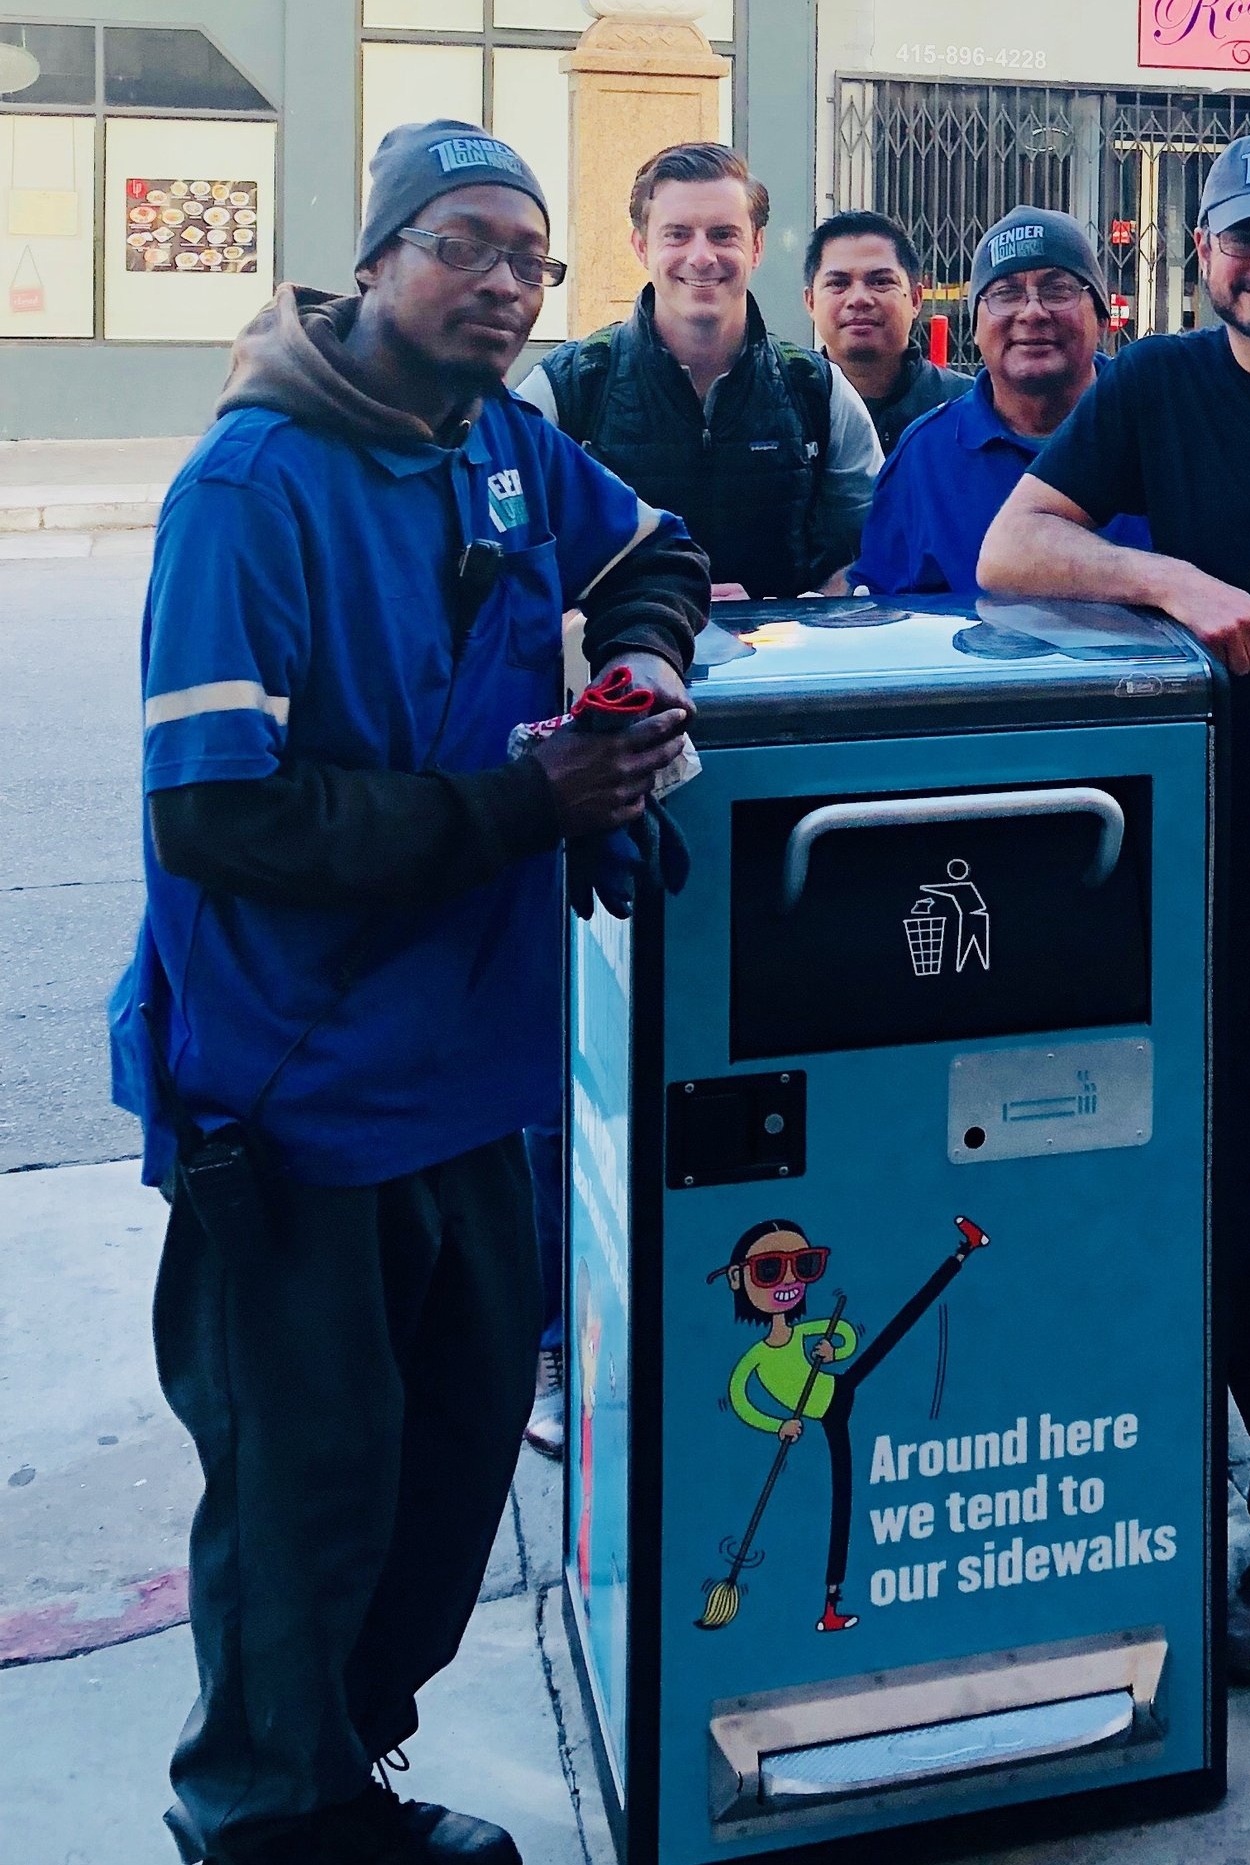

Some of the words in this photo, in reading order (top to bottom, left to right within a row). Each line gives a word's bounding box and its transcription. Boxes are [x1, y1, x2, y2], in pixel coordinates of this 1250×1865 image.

[896, 43, 1047, 70] 415-896-4228
[988, 225, 1044, 267] TENDER
[869, 1416, 1028, 1485] Around
[1039, 1412, 1138, 1461] here
[869, 1501, 935, 1545] we
[945, 1474, 1048, 1533] tend
[1058, 1475, 1105, 1516] to
[870, 1559, 947, 1607] our
[957, 1519, 1177, 1593] sidewalks
